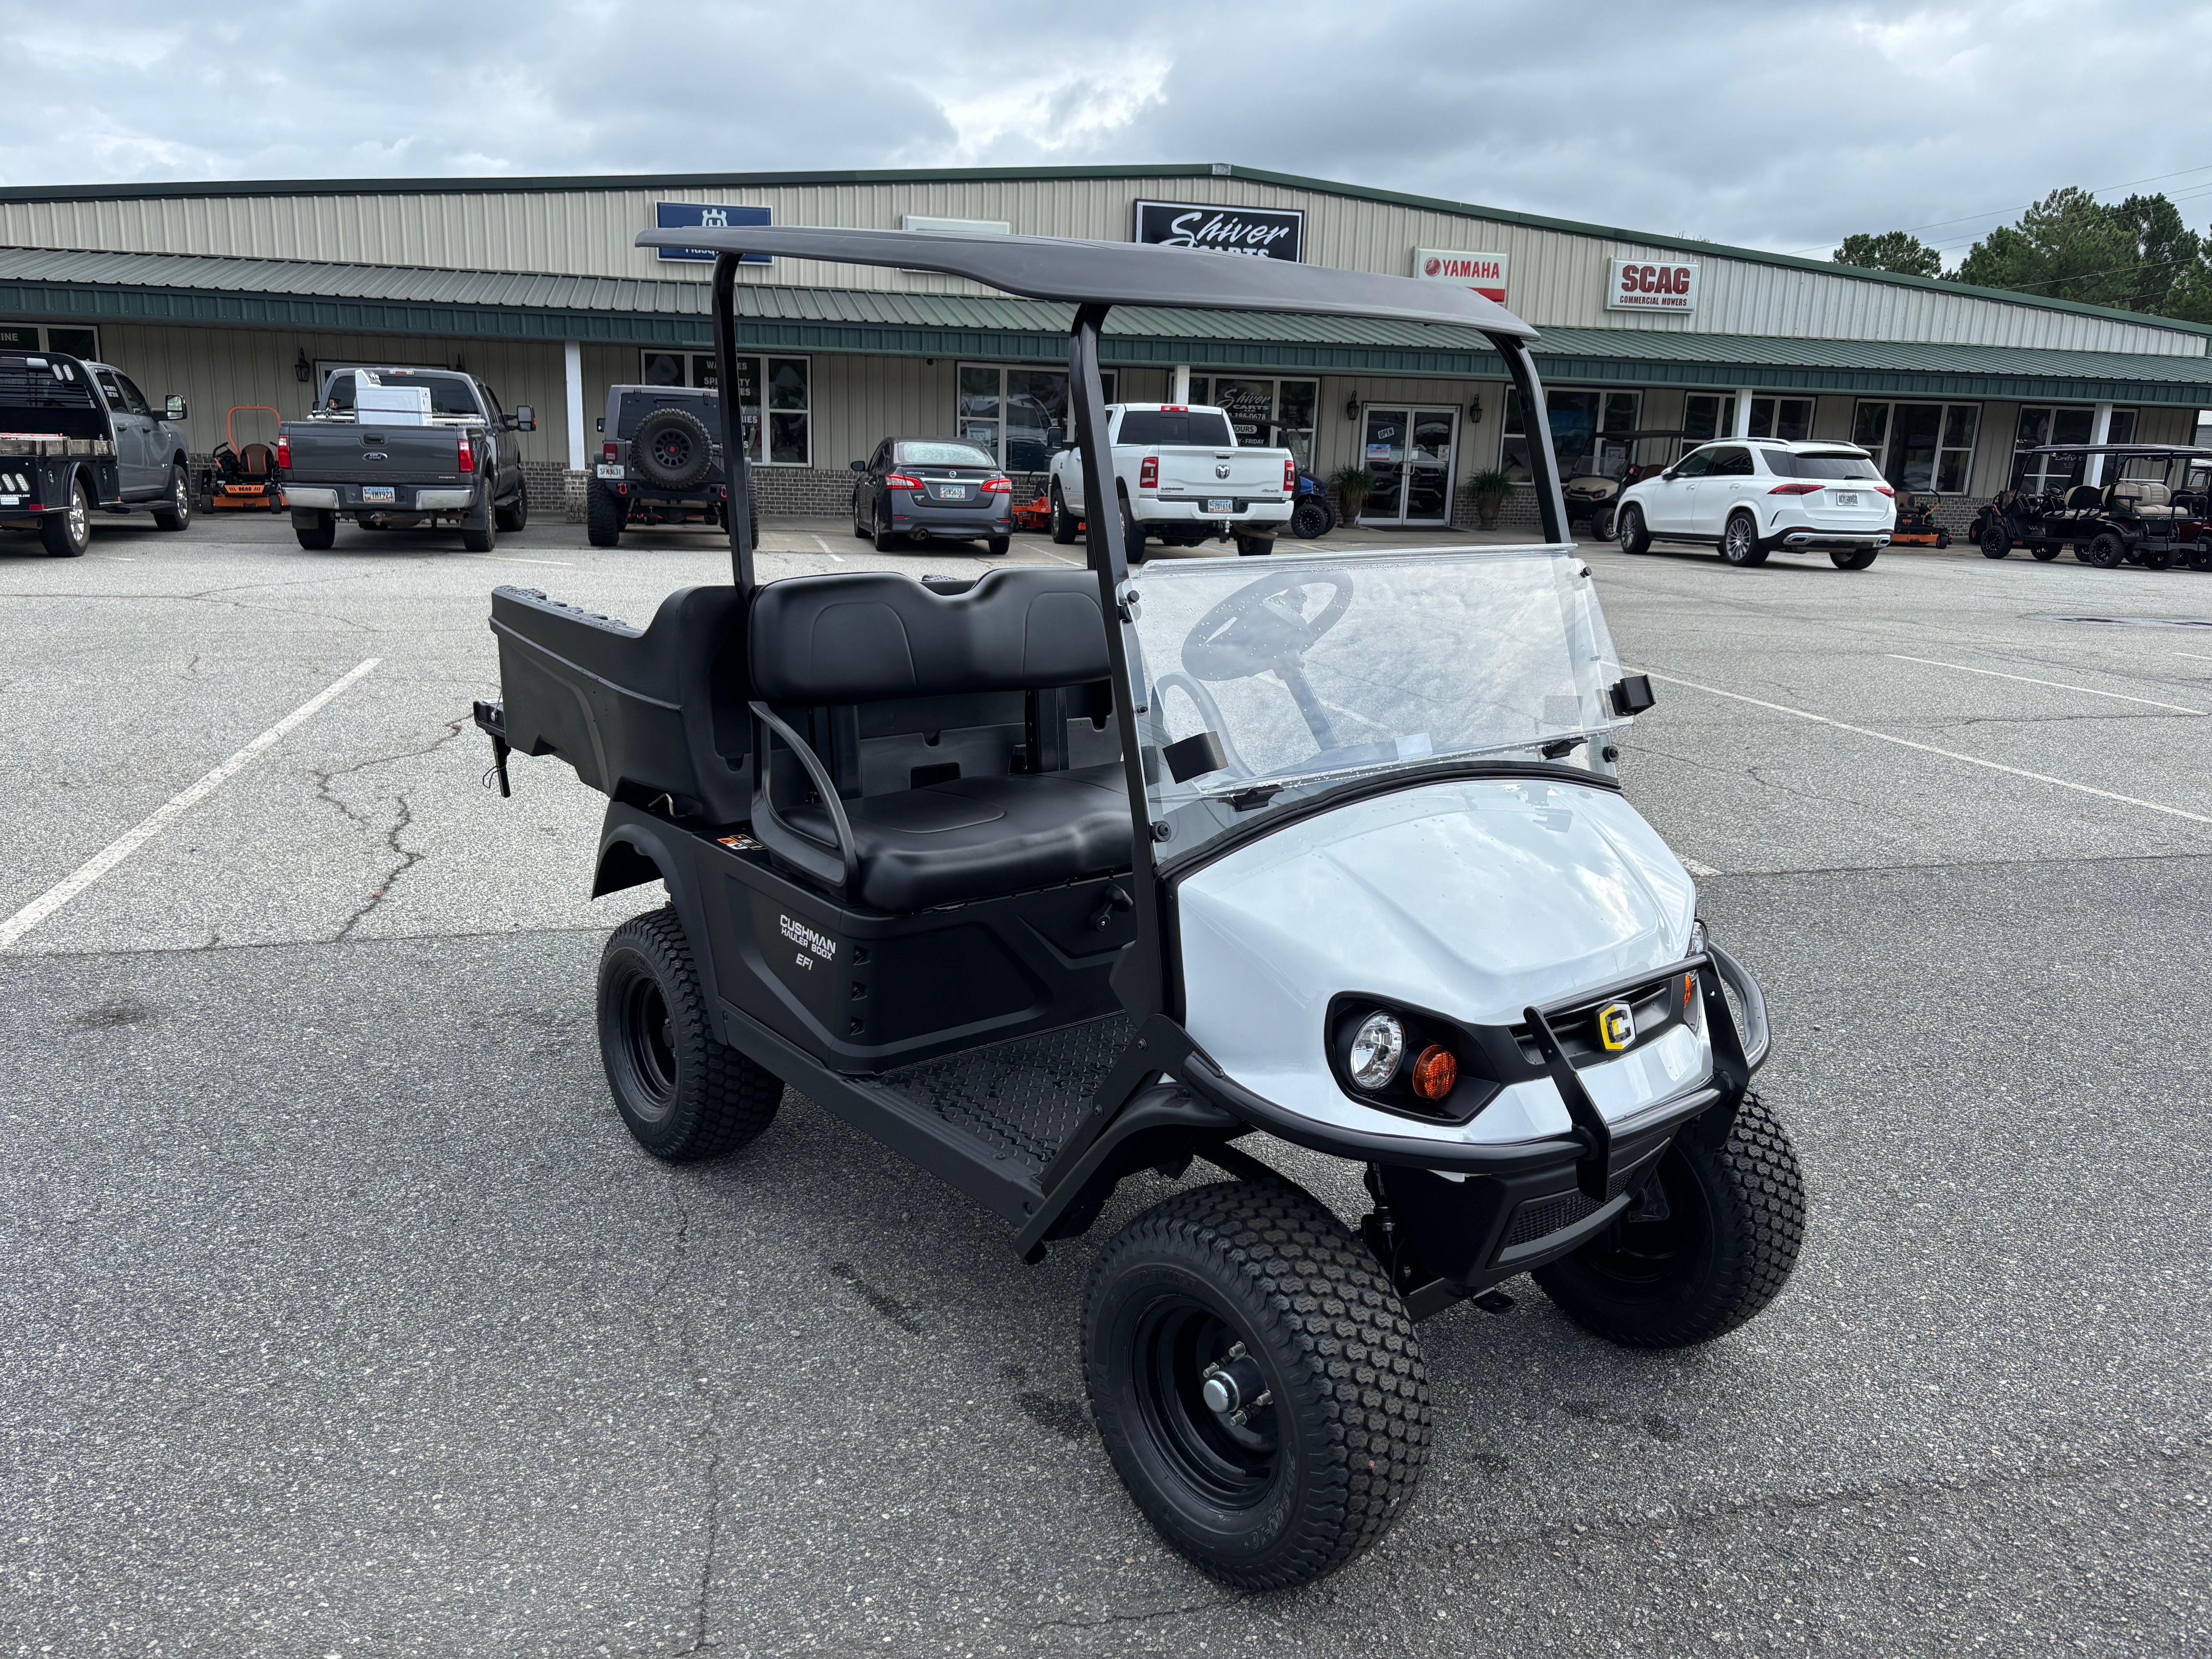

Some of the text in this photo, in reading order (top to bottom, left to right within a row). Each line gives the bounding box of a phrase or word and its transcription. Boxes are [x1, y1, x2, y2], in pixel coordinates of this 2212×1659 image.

[1159, 211, 1290, 247] Shiver
[1443, 259, 1499, 279] YAMAHA
[1621, 264, 1690, 295] SCAG
[1620, 295, 1687, 306] COMMERCIAL MOWERS
[0, 333, 18, 341] INE
[1216, 388, 1271, 409] Shiver
[1379, 428, 1393, 438] OPEN
[780, 914, 836, 954] CUSHMAN
[781, 927, 832, 961] HAULER 800X
[796, 953, 813, 970] EFI
[1151, 1268, 1197, 1289] TURF
[1094, 1363, 1128, 1448] KENDA
